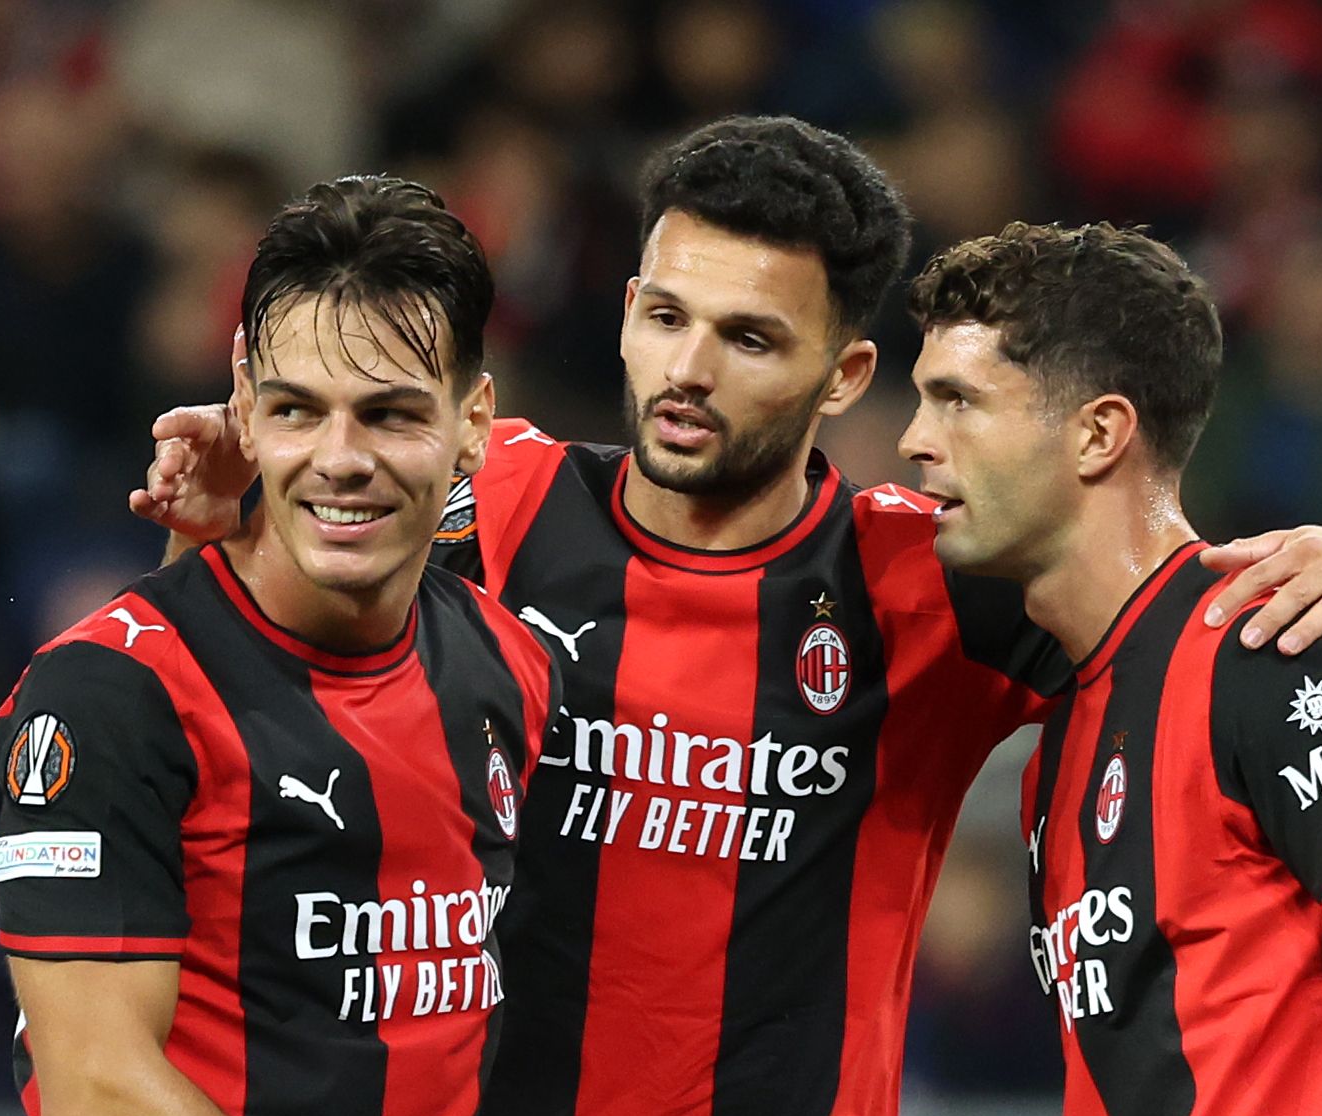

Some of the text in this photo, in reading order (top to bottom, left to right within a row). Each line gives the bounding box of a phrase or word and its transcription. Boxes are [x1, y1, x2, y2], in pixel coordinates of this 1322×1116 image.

[809, 630, 840, 646] ACM
[812, 694, 838, 705] 1899
[560, 783, 795, 862] FLY BETTER
[338, 964, 402, 1023] FLY
